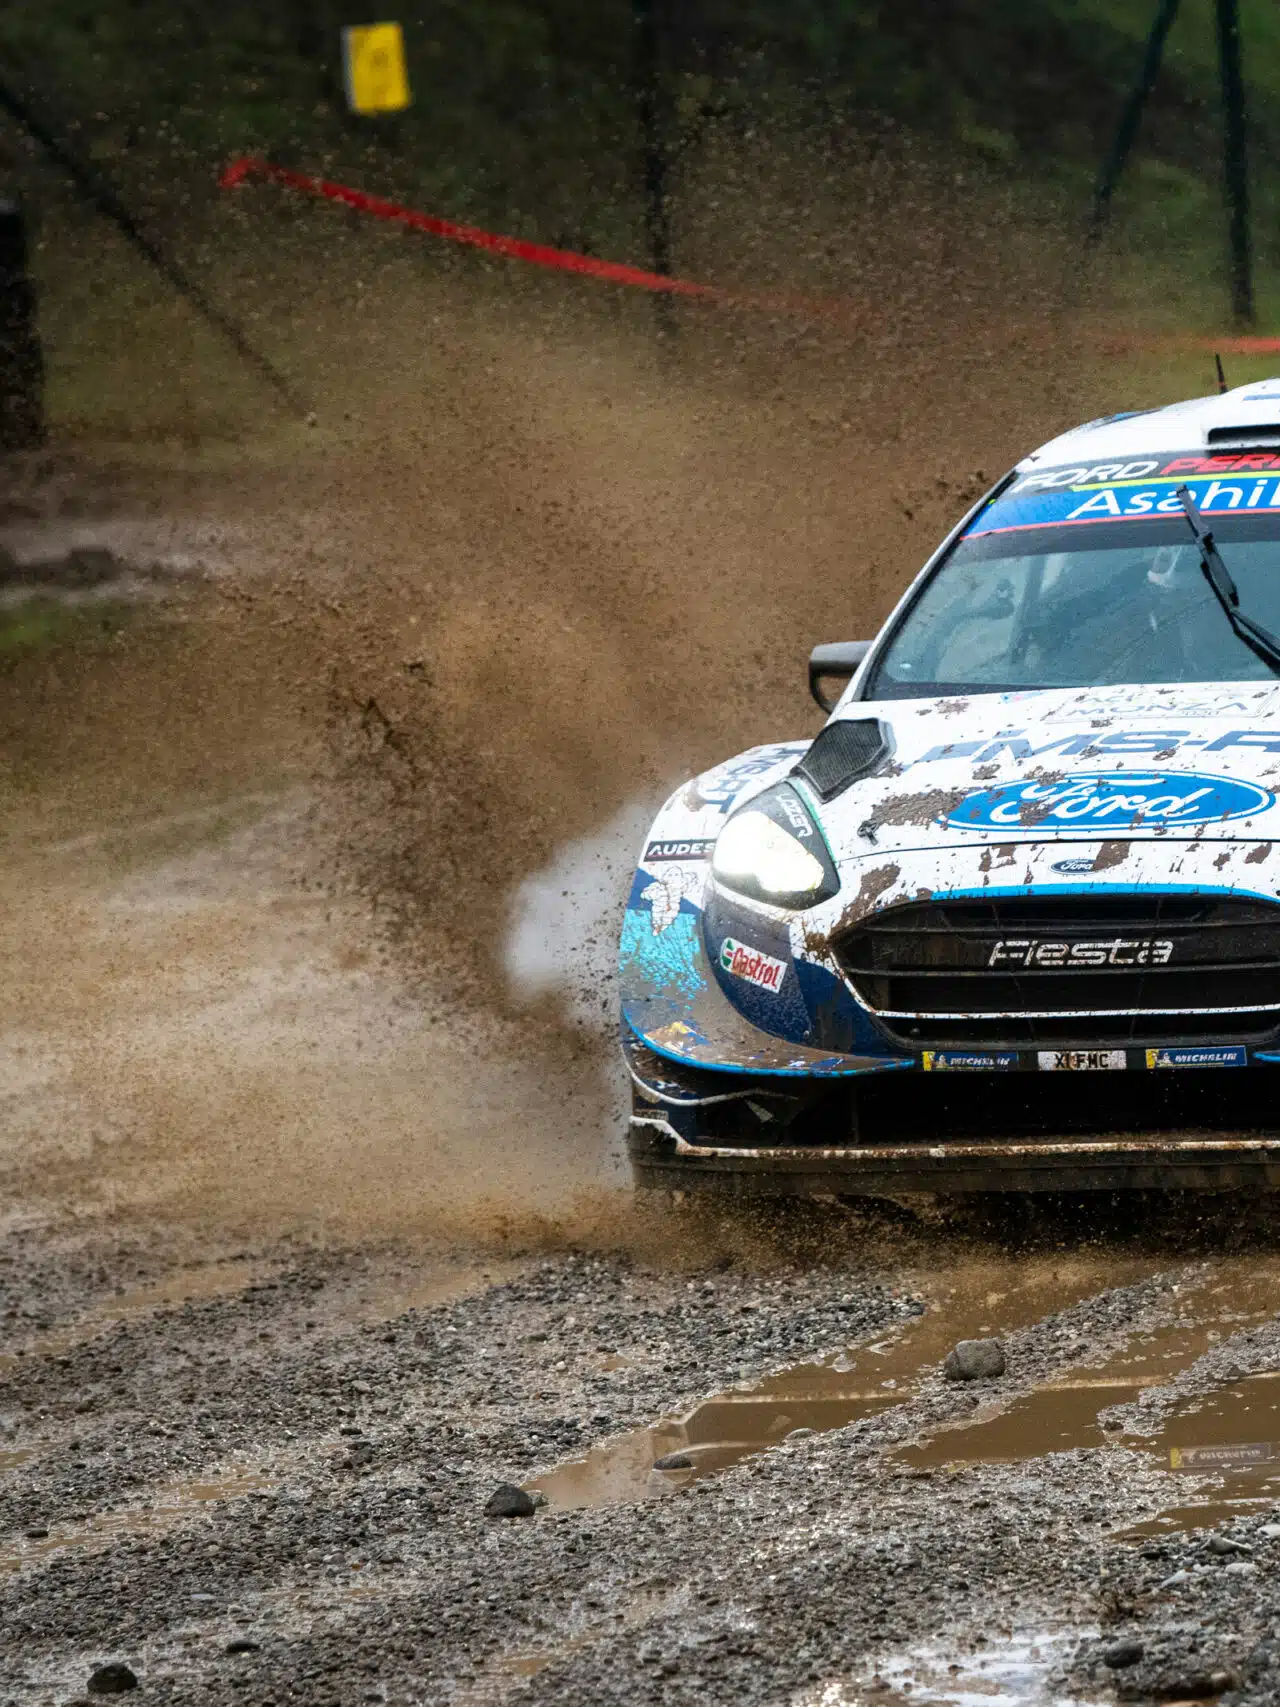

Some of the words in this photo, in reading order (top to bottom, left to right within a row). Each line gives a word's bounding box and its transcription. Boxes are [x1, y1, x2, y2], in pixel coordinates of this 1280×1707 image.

[1011, 461, 1158, 493] FORD
[990, 778, 1214, 823] Ford
[648, 842, 716, 857] AUDES
[733, 948, 780, 987] Castrol
[988, 938, 1174, 967] Fiesta
[1175, 1052, 1238, 1064] MICHELIN
